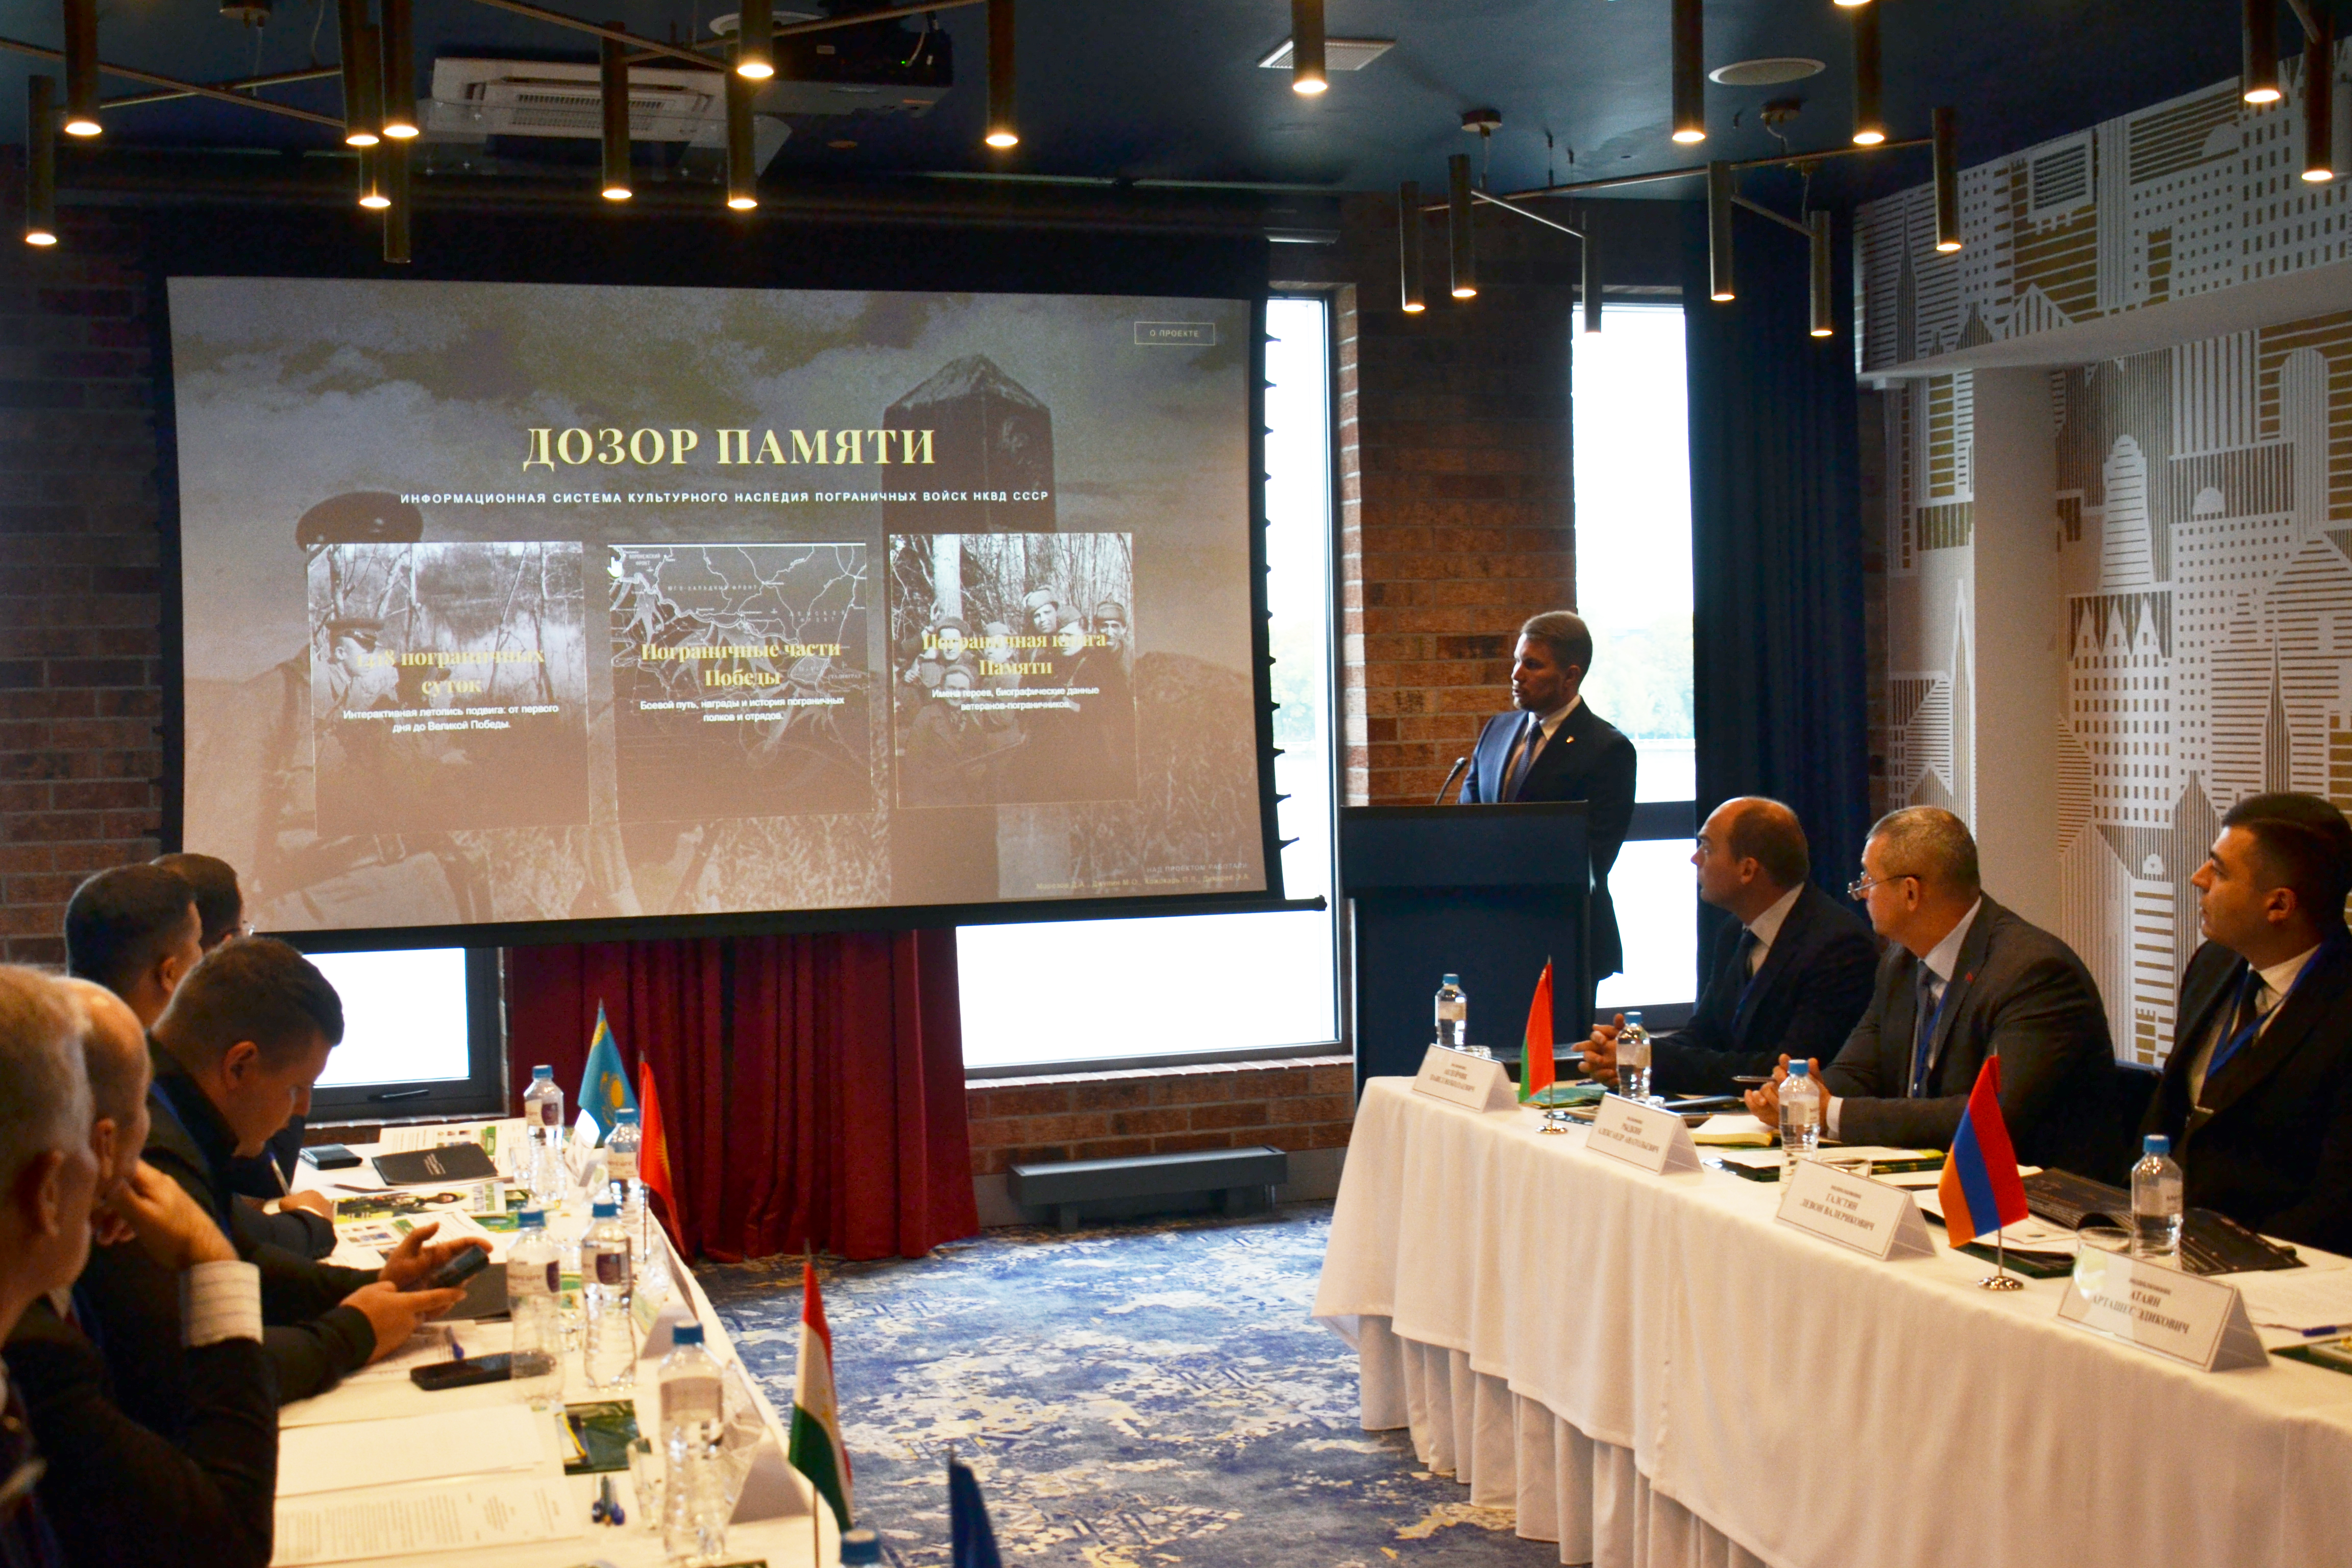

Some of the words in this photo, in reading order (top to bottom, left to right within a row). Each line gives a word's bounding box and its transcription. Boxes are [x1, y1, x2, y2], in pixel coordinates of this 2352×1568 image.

[523, 428, 698, 472] ДОЗОР
[716, 429, 936, 465] ПАМЯТИ
[400, 493, 546, 505] ИНФОРМАЦИОННАЯ
[552, 493, 622, 503] СИСТЕМА
[628, 493, 728, 503] КУЛЬТУРНОГО
[734, 492, 809, 504] НАСЛЕДИЯ
[815, 492, 917, 502] ПОГРАНИЧНЫХ
[923, 489, 968, 502] ВОЙСК
[973, 491, 1008, 503] НКВД
[1013, 491, 1049, 501] СССР
[922, 633, 1048, 653] Пограничная
[1052, 633, 1107, 648] книга
[401, 648, 545, 669] пограничных
[641, 643, 779, 663] Пограничные
[784, 642, 842, 657] части
[979, 659, 1053, 676] Памяти
[705, 669, 781, 687] Победы
[421, 679, 482, 698] суток
[932, 689, 961, 699] Имена
[962, 688, 994, 699] героев,
[995, 687, 1066, 697] биографические
[1067, 687, 1100, 696] данные
[640, 699, 674, 710] Боевой
[676, 700, 699, 710] путь,
[701, 699, 739, 710] награды
[749, 698, 786, 708] история
[787, 697, 845, 708] пограничных
[961, 701, 1071, 712] ветеранов-пограничников.
[344, 708, 418, 720] Интерактивная
[419, 708, 463, 718] летопись
[465, 707, 506, 717] подвига:
[521, 705, 559, 716] первого
[703, 714, 734, 722] полков
[745, 712, 784, 723] отрядов.
[393, 724, 411, 734] дня
[413, 723, 426, 733] до
[428, 721, 469, 731] Великой
[471, 720, 511, 730] Победы.
[2130, 1290, 2162, 1308] АТАЯН
